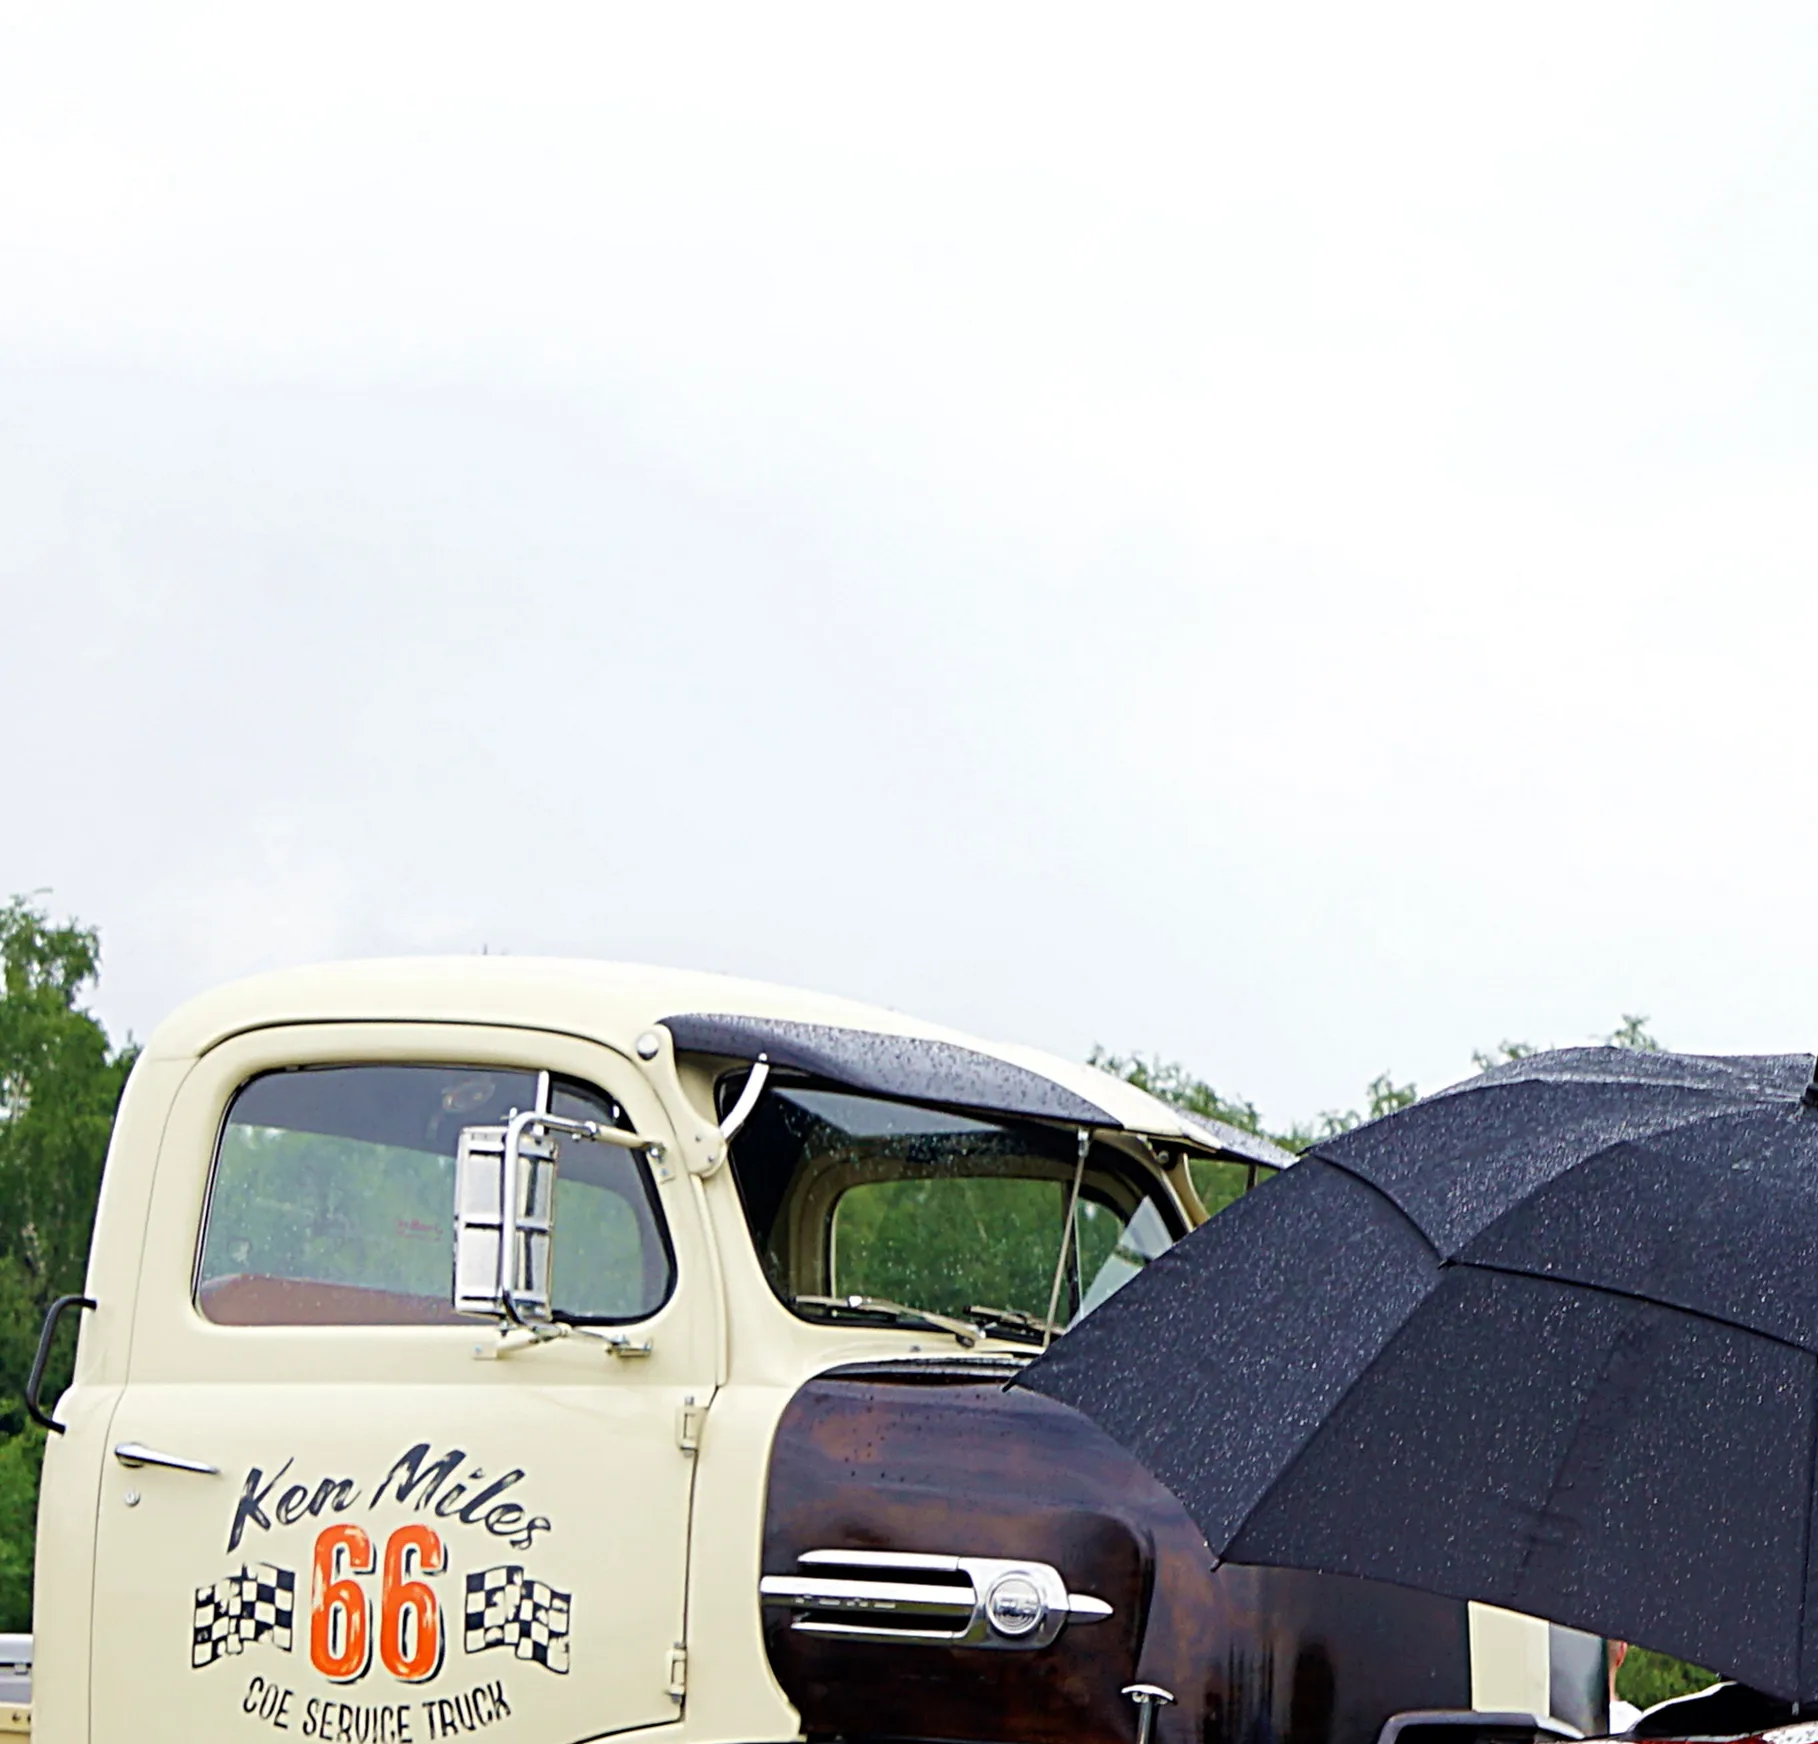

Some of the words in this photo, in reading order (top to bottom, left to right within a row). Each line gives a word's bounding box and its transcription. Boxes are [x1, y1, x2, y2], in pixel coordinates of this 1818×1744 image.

[227, 1457, 362, 1554] Ken
[369, 1443, 552, 1550] Miles
[309, 1523, 449, 1684] 66
[242, 1676, 295, 1730] COE
[302, 1698, 414, 1744] SERVICE
[422, 1680, 512, 1741] TRUCK
